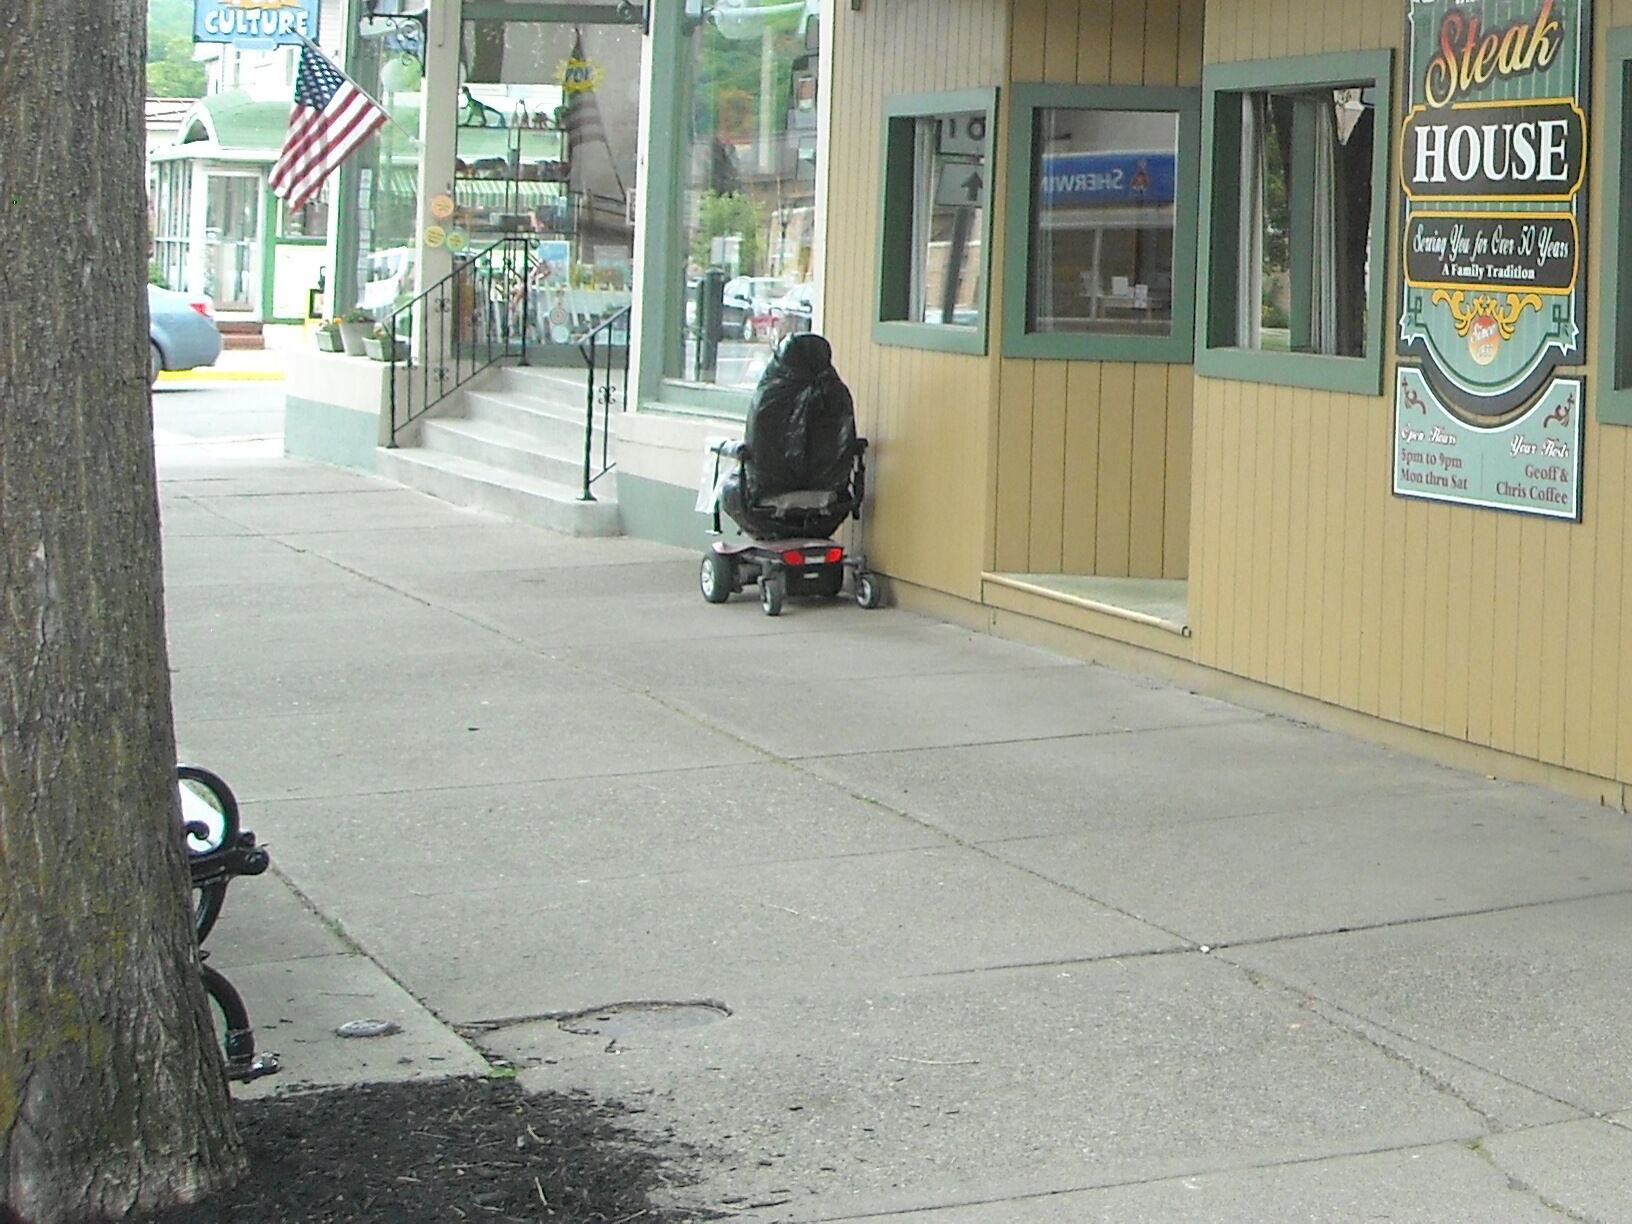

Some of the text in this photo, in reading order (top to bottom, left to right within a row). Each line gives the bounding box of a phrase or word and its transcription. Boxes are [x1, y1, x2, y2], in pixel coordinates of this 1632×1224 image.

[204, 9, 309, 36] CULTURE
[1412, 120, 1568, 183] HOUSE
[1413, 223, 1569, 267] Serving You for Over 50 Years
[1442, 264, 1535, 280] A Family Tradition
[1401, 423, 1456, 445] Open Hours
[1510, 434, 1569, 458] Your Hosts
[1426, 453, 1437, 465] to
[1439, 452, 1462, 471] 9pm
[1401, 468, 1468, 490] Mon thru Sat
[1525, 464, 1569, 483] Geoff &
[1496, 481, 1568, 505] Chris Coffee
